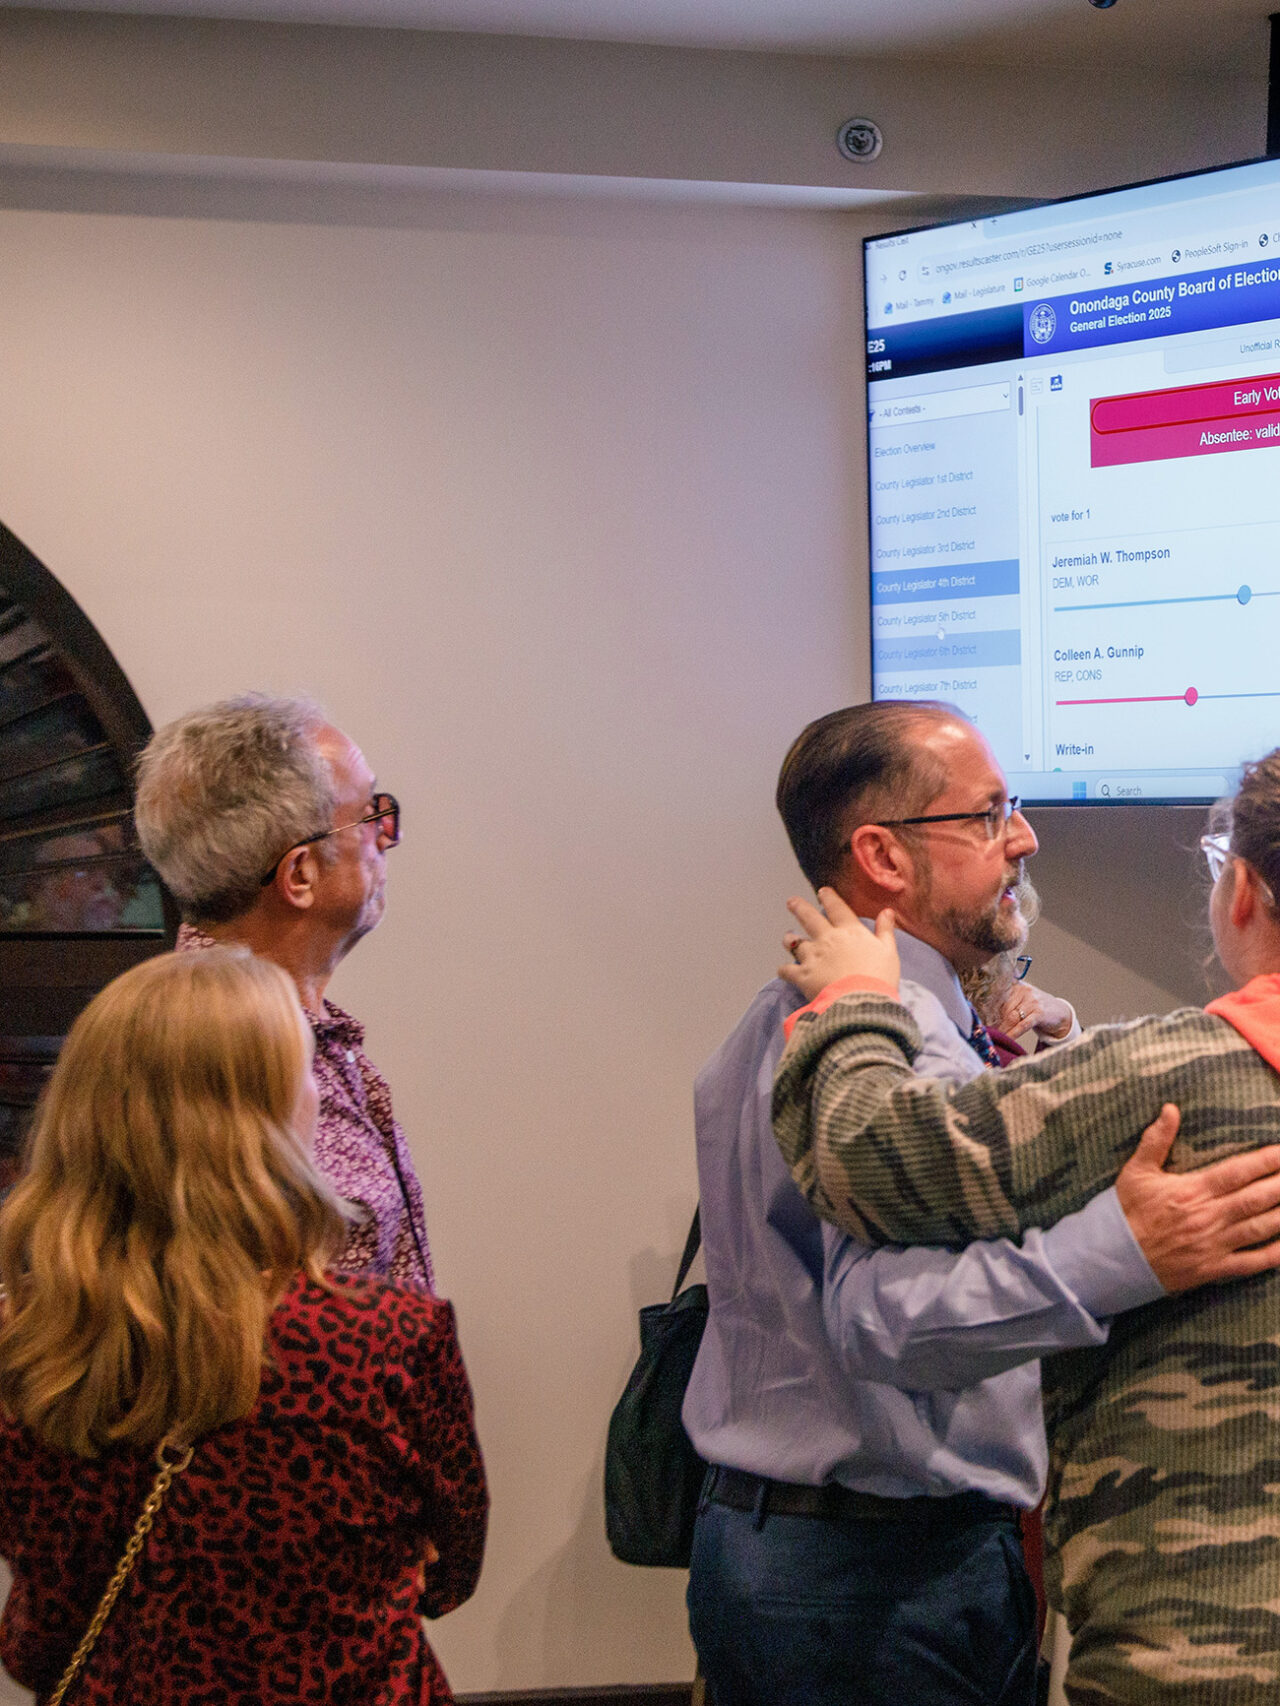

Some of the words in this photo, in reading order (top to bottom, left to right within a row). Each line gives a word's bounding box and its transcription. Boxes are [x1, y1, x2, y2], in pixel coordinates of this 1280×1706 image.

[1185, 244, 1222, 260] PeopleSoft
[1223, 239, 1248, 252] Sign-in
[1116, 255, 1161, 272] Syracuse.com
[1026, 276, 1049, 288] Google
[1050, 270, 1078, 283] Calendar
[954, 290, 968, 300] Mail
[1070, 293, 1130, 315] Onondaga
[1132, 285, 1175, 304] County
[1178, 277, 1216, 297] Board
[1218, 274, 1232, 290] of
[1070, 316, 1106, 333] General
[1108, 310, 1146, 327] Election
[1148, 306, 1172, 320] 2025
[1240, 339, 1272, 354] Unofficial
[1234, 390, 1261, 406] Early
[1200, 428, 1253, 446] Absentee:
[1255, 424, 1280, 438] valid
[875, 446, 902, 458] Election
[904, 442, 936, 454] Overview
[875, 480, 899, 491] County
[902, 475, 935, 489] Legislator
[949, 471, 973, 482] District
[876, 515, 900, 526] County
[902, 509, 935, 524] Legislator
[952, 506, 976, 517] District
[1051, 512, 1069, 523] vote
[1071, 510, 1084, 520] for
[877, 549, 901, 559] County
[903, 543, 936, 557] Legislator
[951, 540, 975, 551] District
[1052, 552, 1098, 568] Jeremiah
[1100, 551, 1113, 564] W.
[1115, 548, 1171, 563] Thompson
[877, 583, 901, 593] County
[903, 579, 936, 592] Legislator
[951, 576, 976, 586] District
[1053, 577, 1075, 589] DEM,
[1077, 574, 1099, 587] WOR
[878, 616, 902, 627] County
[904, 613, 937, 626] Legislator
[951, 610, 976, 621] District
[1054, 649, 1091, 661] Colleen
[1094, 647, 1104, 659] A.
[1107, 645, 1144, 659] Gunnip
[1055, 671, 1074, 682] REP,
[1076, 669, 1102, 681] CONS
[879, 684, 902, 694] County
[905, 682, 938, 693] Legislator
[953, 680, 977, 690] District
[1055, 743, 1094, 756] Write-in
[1115, 785, 1142, 796] Search
